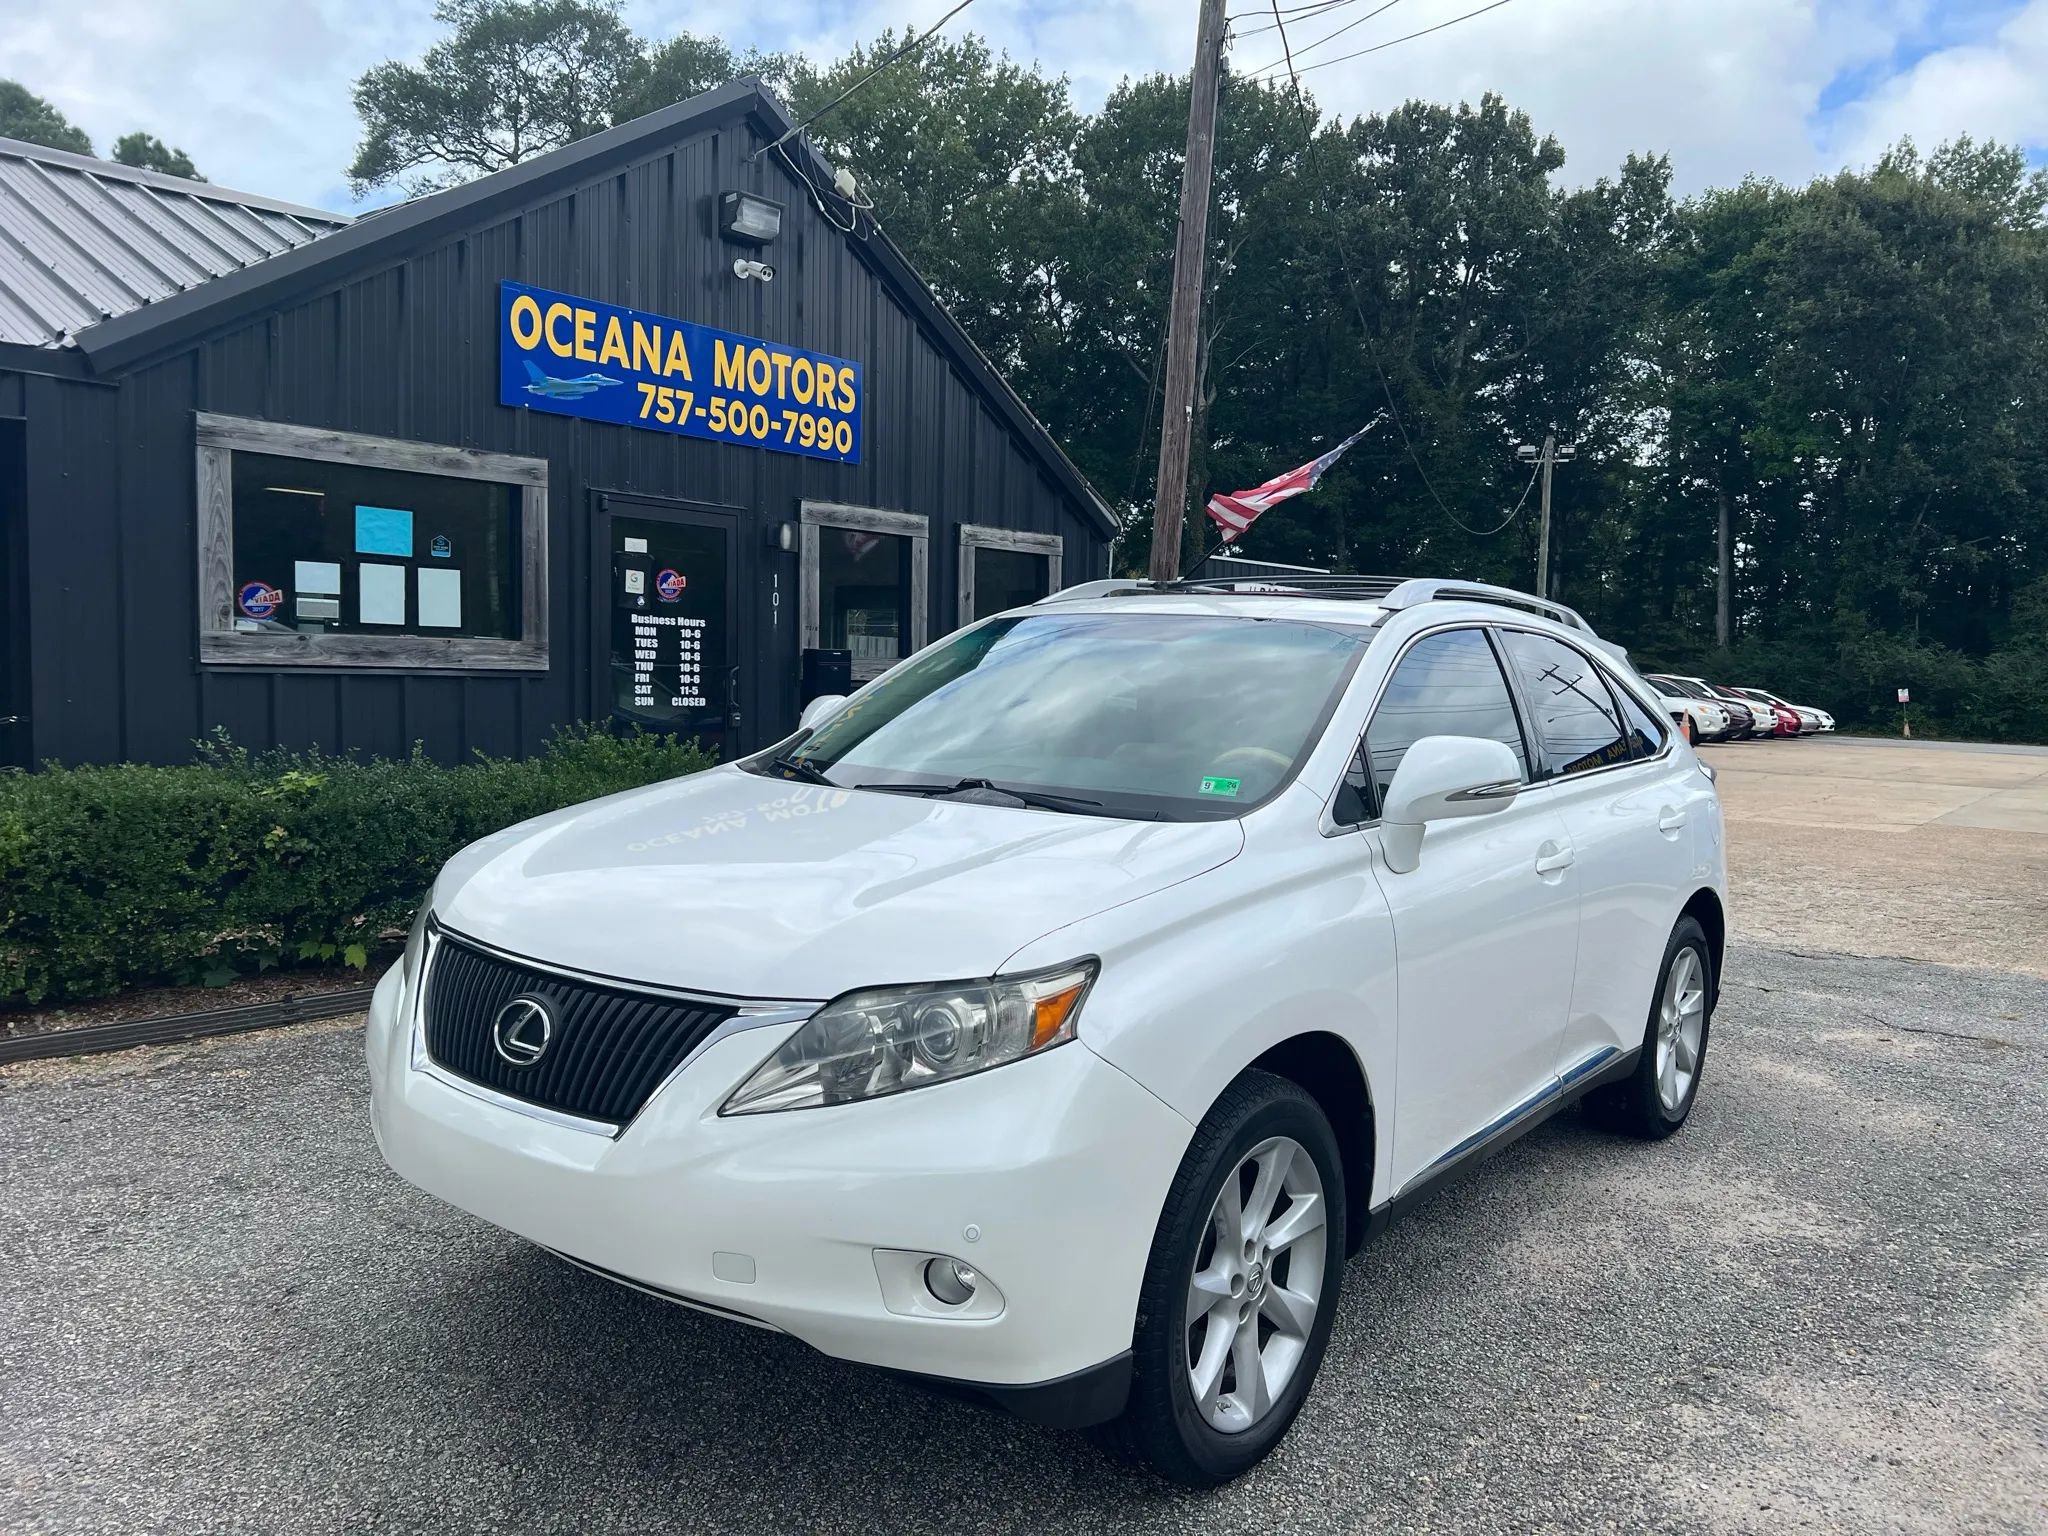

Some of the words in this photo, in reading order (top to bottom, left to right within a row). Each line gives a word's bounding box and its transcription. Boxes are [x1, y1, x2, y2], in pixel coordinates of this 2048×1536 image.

[510, 295, 692, 381] OCEANA
[714, 339, 856, 413] MOTORS
[637, 382, 853, 454] 757-500-7990
[667, 577, 685, 588] VIADA
[254, 591, 281, 604] VIADA
[631, 613, 676, 626] Business
[677, 616, 706, 627] Hours
[635, 626, 656, 636] MON
[680, 628, 701, 639] 10-6
[635, 637, 658, 648] TUES
[680, 640, 701, 650] 10-6
[635, 649, 656, 660] WED
[680, 651, 701, 662] 10-6
[635, 661, 653, 672] THU
[680, 663, 700, 673] 10-6
[635, 673, 650, 683] FRI
[680, 674, 700, 684] 10-6
[635, 685, 652, 695] SAT
[680, 686, 699, 695] 11-5
[634, 697, 654, 706] SUN
[671, 697, 706, 707] CLOSED
[1204, 782, 1211, 790] 9
